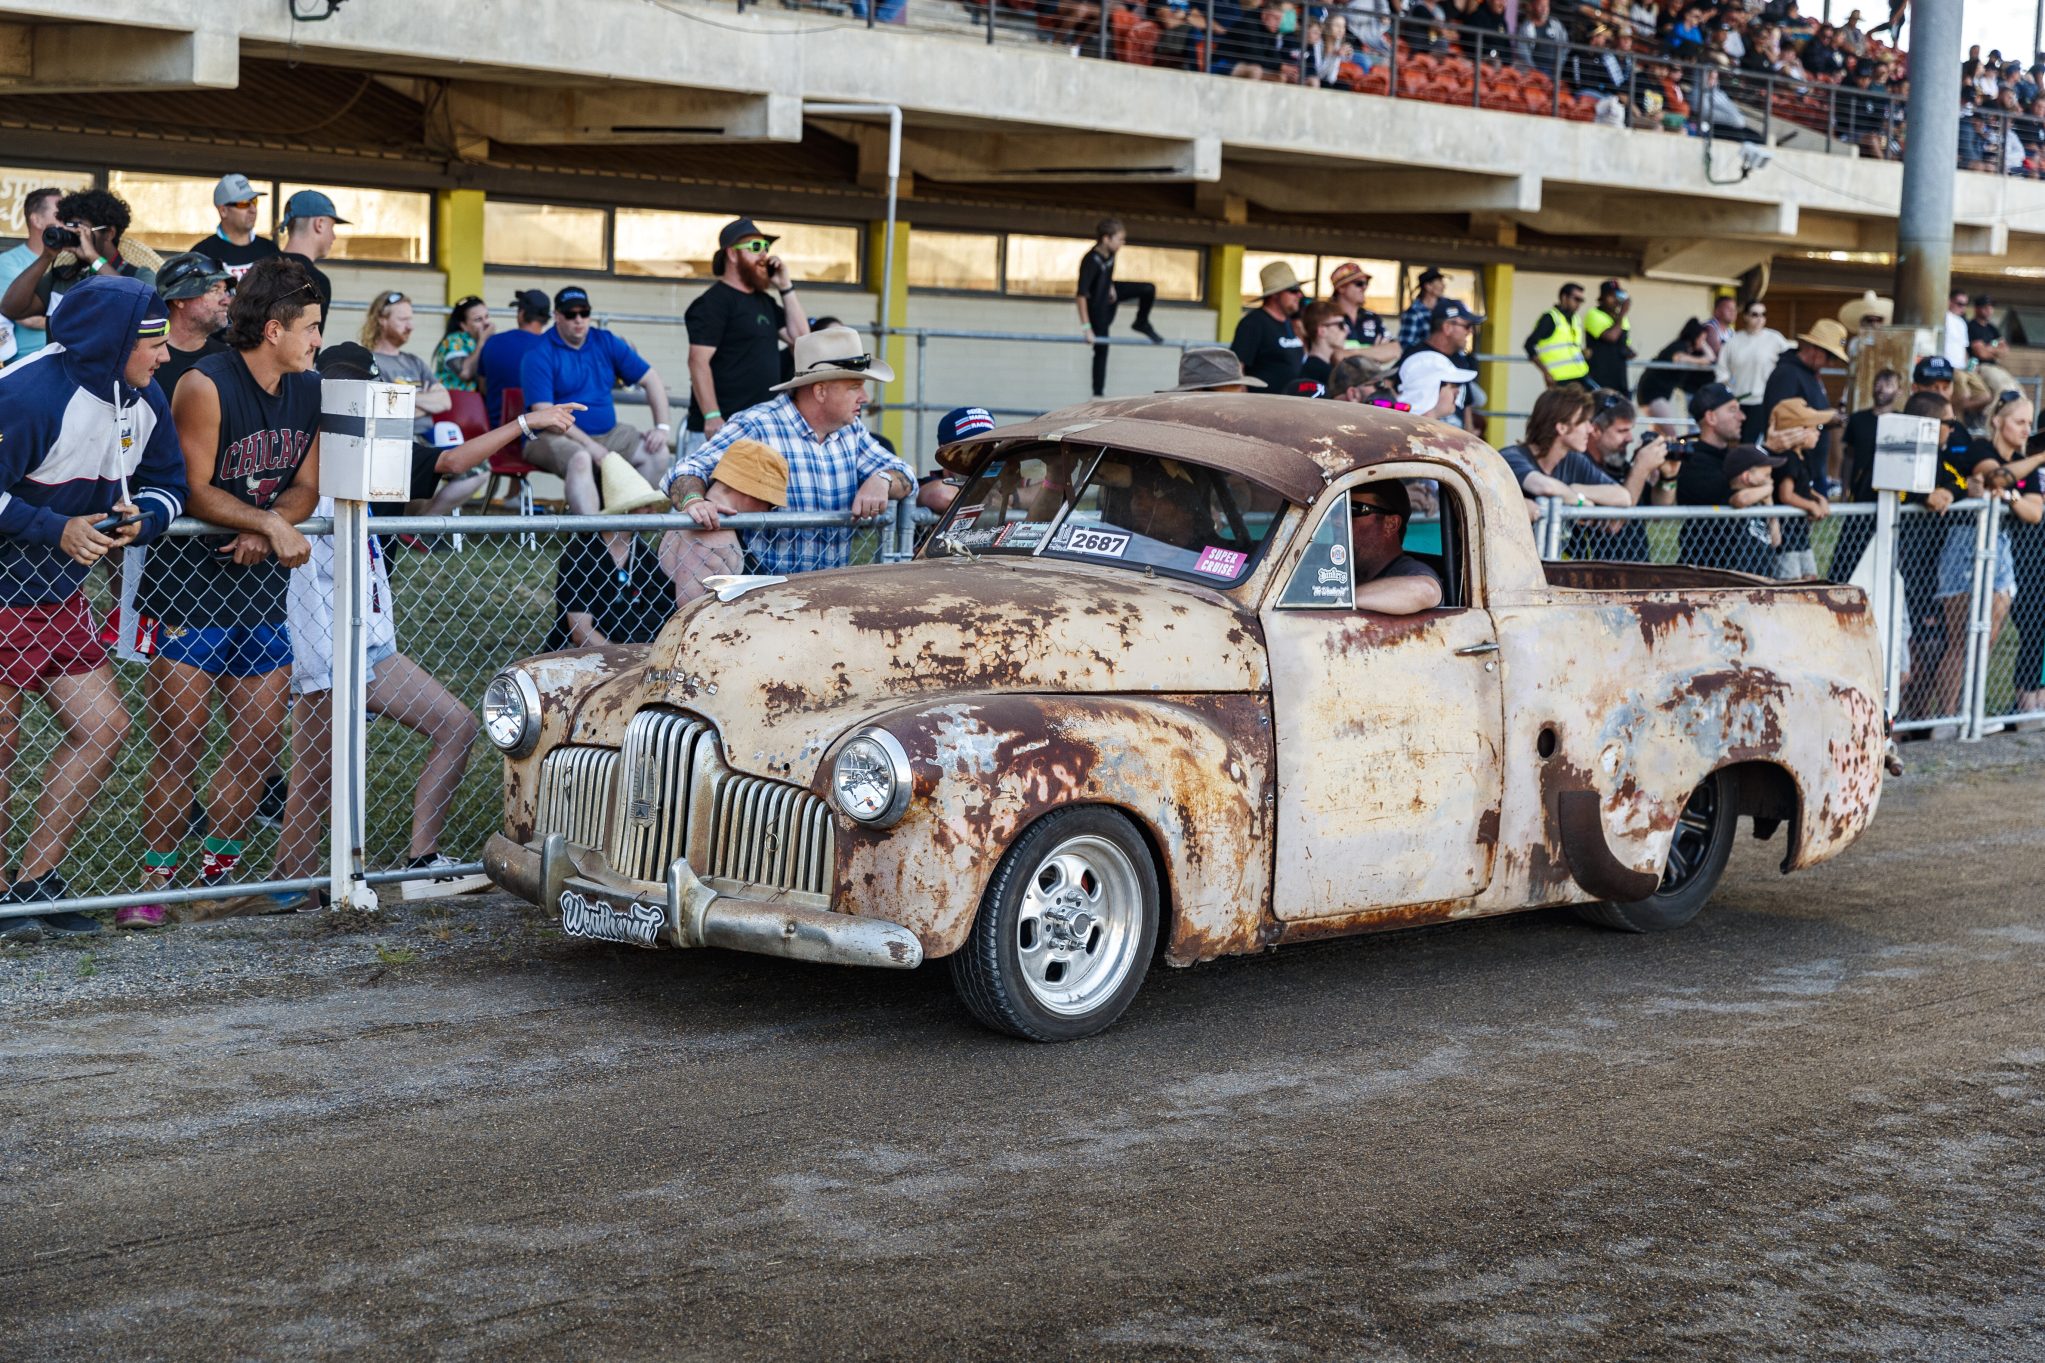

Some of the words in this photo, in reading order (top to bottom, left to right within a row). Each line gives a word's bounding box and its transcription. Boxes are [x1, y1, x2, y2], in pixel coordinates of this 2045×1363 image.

[220, 428, 310, 480] CHICAG
[1071, 533, 1125, 553] 2687
[1208, 547, 1239, 564] SUPER
[1200, 559, 1235, 576] CRUISE
